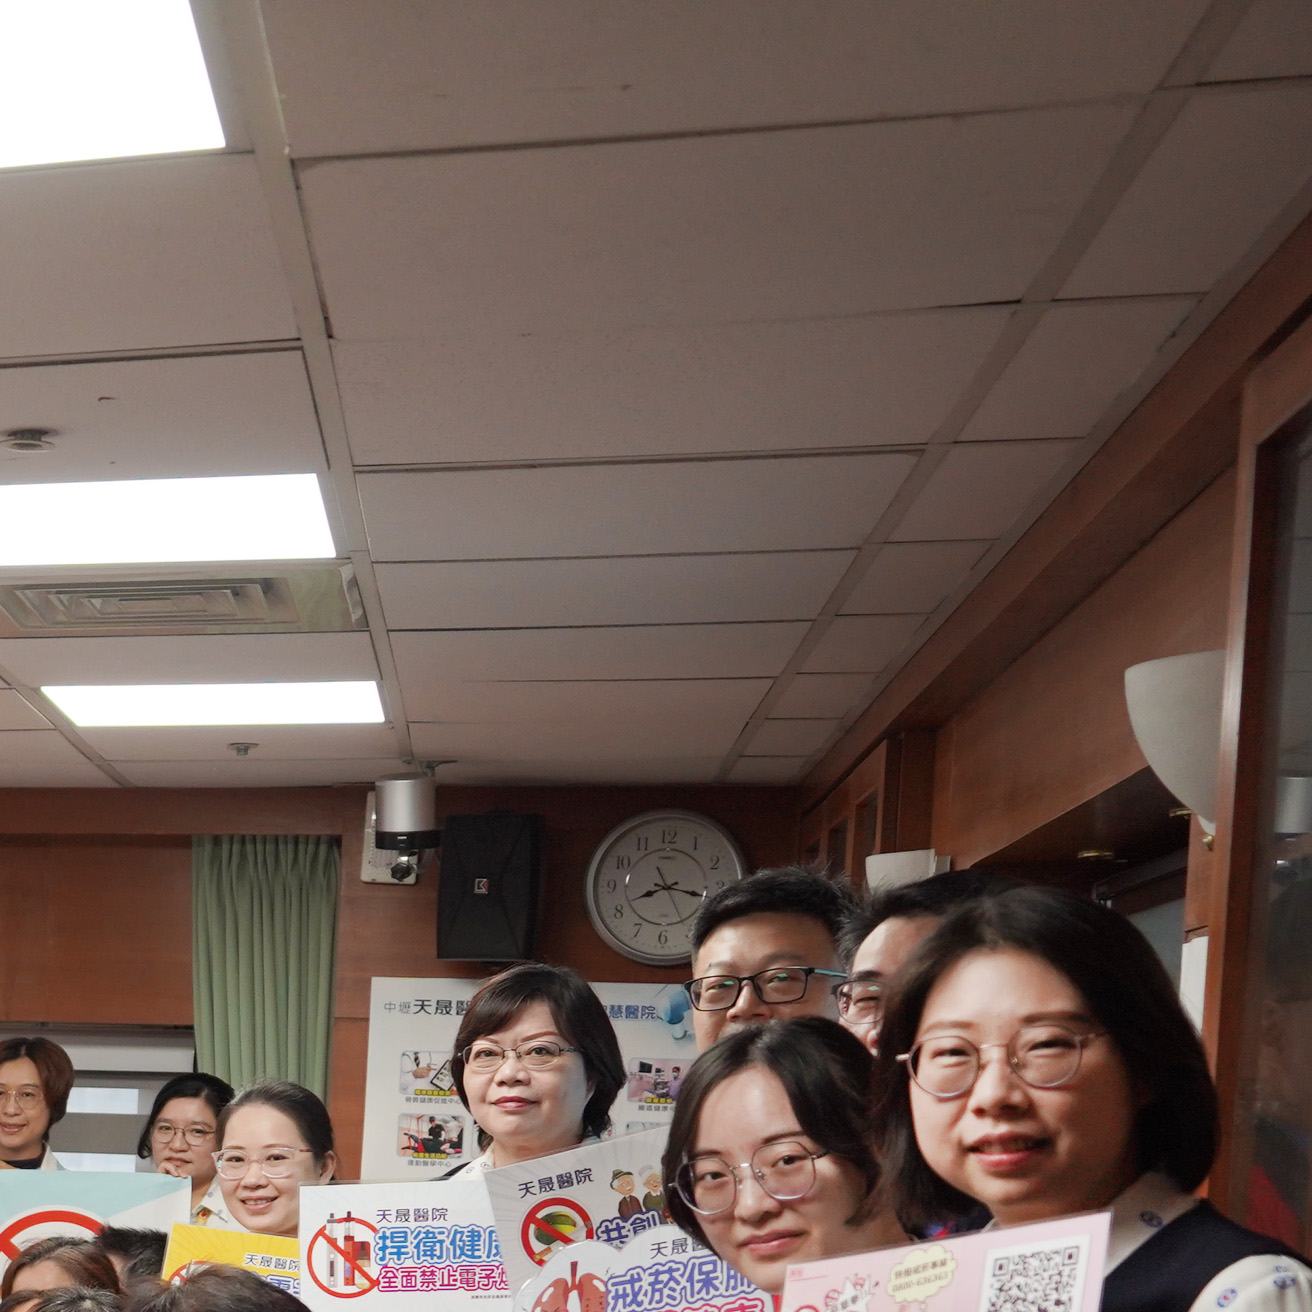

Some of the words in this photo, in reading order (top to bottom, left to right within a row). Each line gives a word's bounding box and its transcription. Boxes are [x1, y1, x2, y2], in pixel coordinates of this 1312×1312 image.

[636, 837, 648, 850] 11
[662, 830, 677, 844] 12
[692, 836, 698, 850] 1
[616, 855, 631, 870] 10
[710, 856, 720, 870] 2
[607, 879, 616, 894] 9
[614, 904, 624, 919] 8
[633, 923, 642, 938] 7
[658, 930, 668, 944] 6
[518, 1168, 595, 1199] 天晟醫院
[376, 1207, 449, 1224] 天晟醫院
